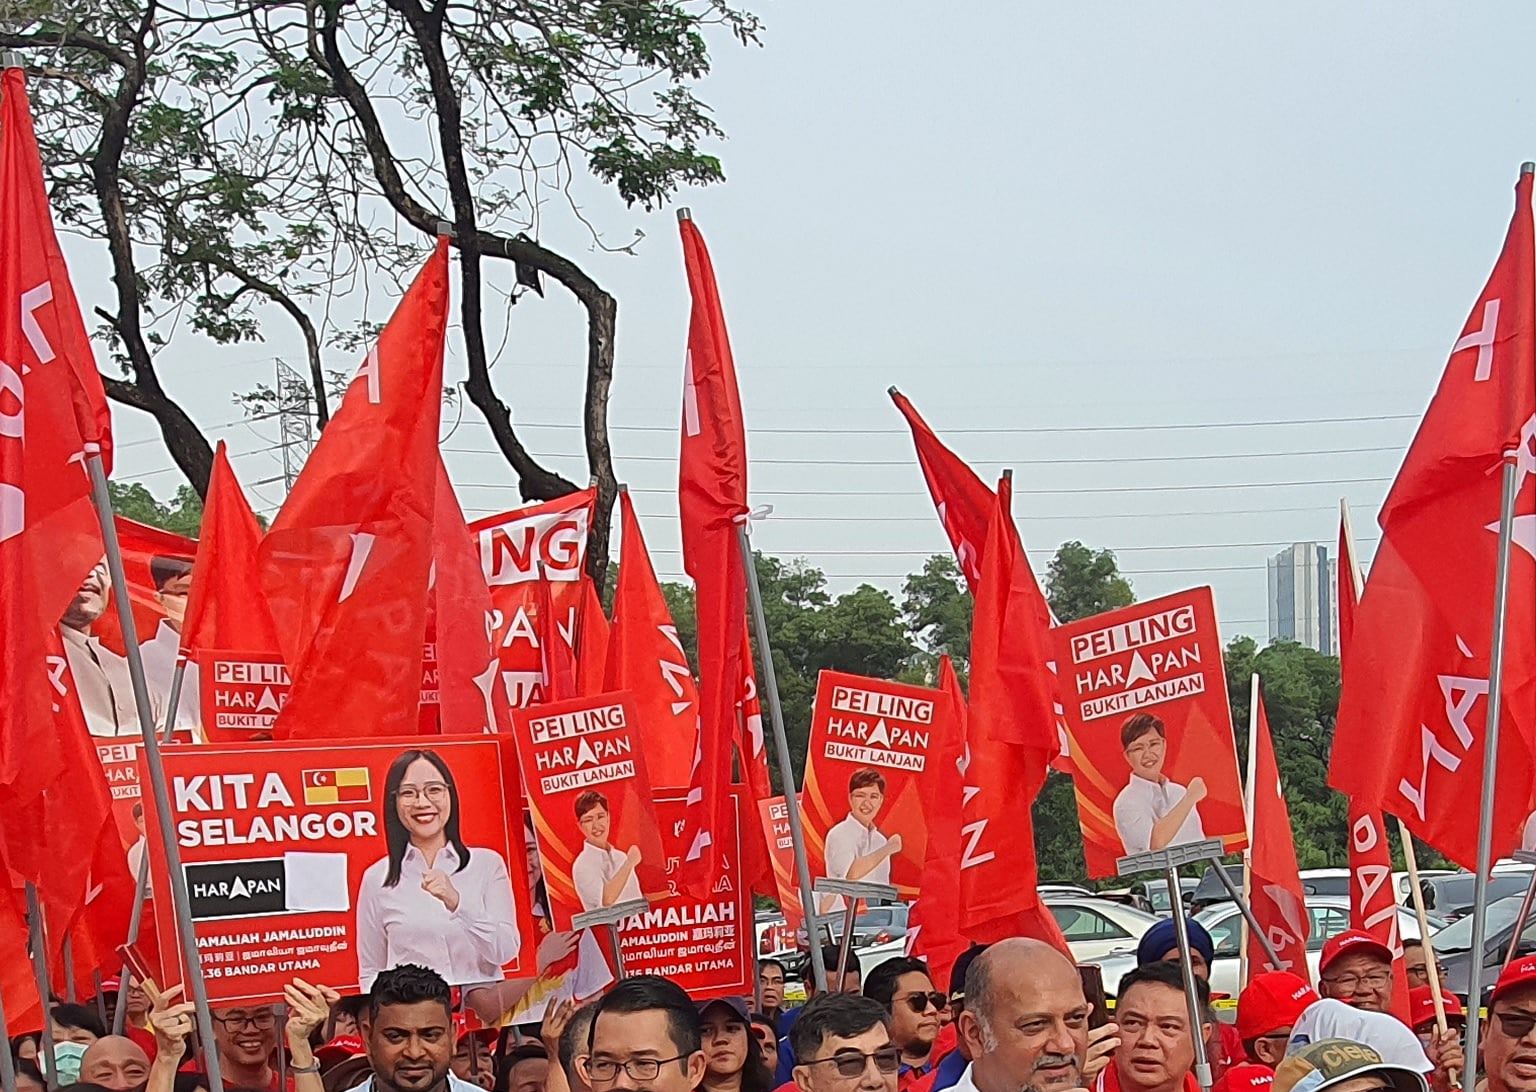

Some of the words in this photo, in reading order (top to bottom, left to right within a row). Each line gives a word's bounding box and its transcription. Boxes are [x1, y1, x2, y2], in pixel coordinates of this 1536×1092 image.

[1073, 629, 1115, 660] PEI
[1124, 608, 1193, 647] LING
[217, 664, 252, 682] PEI
[1076, 643, 1201, 694] HARAPAN
[835, 688, 869, 712] PEI
[876, 695, 930, 721] LING
[1083, 694, 1130, 717] BUKIT
[1135, 675, 1202, 704] LANJAN
[218, 716, 257, 726] BUKIT
[532, 717, 566, 741] PEI
[572, 707, 623, 733] LING
[827, 717, 929, 749] HARAPAN
[535, 736, 631, 771] HARAPAN
[827, 744, 866, 760] BUKIT
[869, 751, 923, 769] LANJAN
[543, 773, 579, 791] BUKIT
[584, 763, 633, 782] LANJAN
[173, 773, 295, 812] KITA
[178, 811, 377, 847] SELANGOR
[194, 876, 281, 899] HARAPAN
[616, 902, 735, 932] JAMALIAH
[262, 926, 347, 943] JAMALUDDIN
[620, 931, 688, 948] AMALUDDIN
[224, 963, 276, 977] BANDAR
[278, 959, 321, 972] UTAMA
[695, 958, 734, 972] UTAMA
